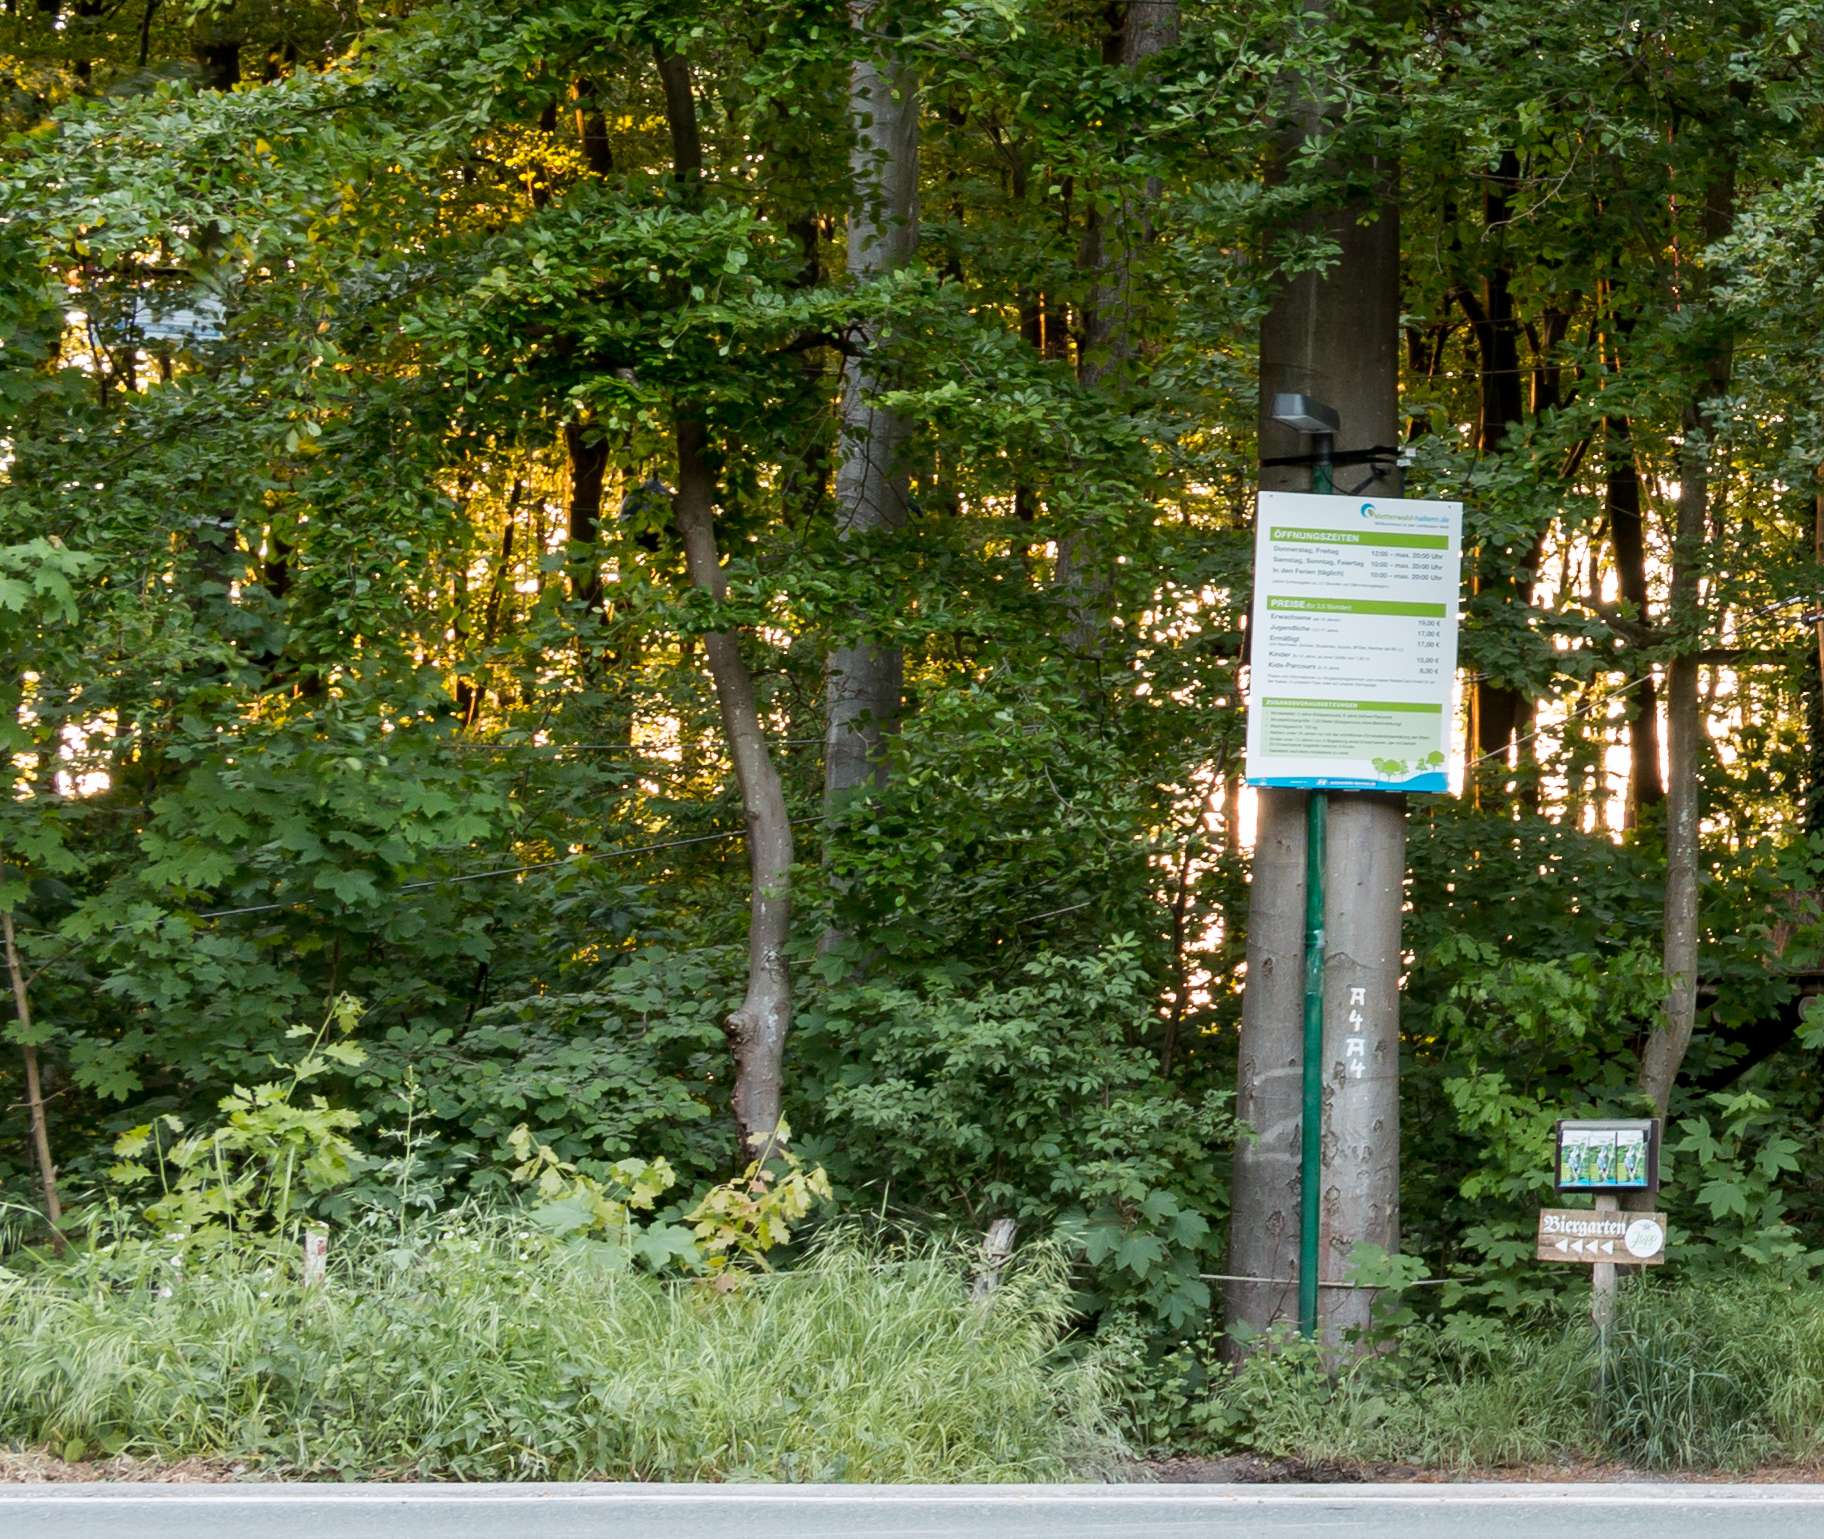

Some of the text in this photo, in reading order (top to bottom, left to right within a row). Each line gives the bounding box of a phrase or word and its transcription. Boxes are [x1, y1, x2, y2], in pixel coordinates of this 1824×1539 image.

[1274, 529, 1360, 543] ÖFFNUNGSZEITEN
[1274, 545, 1313, 554] Donnerstag,
[1273, 556, 1303, 564] Samstag,
[1306, 558, 1335, 566] Sonntag,
[1337, 559, 1364, 567] Feiertag
[1270, 599, 1305, 608] PREISE
[1271, 613, 1311, 621] Erwachsene
[1543, 1215, 1626, 1237] Biergarten
